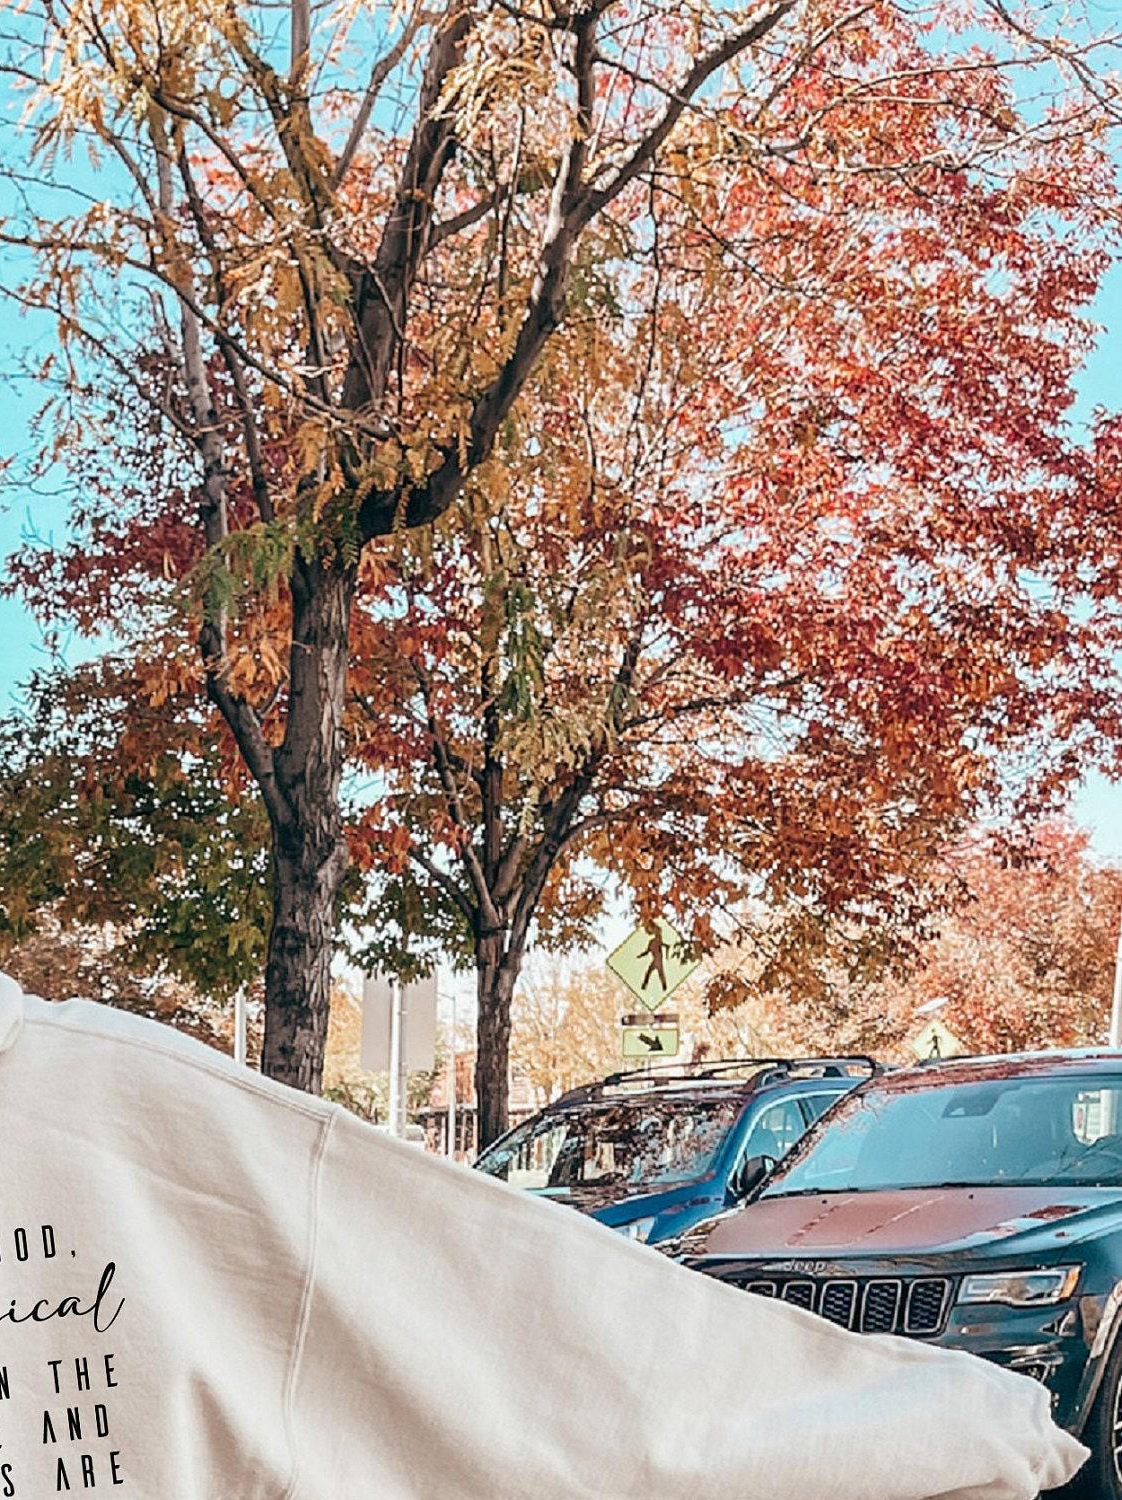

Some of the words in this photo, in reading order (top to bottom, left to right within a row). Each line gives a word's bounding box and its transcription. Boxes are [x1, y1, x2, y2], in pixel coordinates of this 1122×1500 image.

[782, 1258, 826, 1275] Jeep
[47, 1353, 118, 1394] THE
[42, 1403, 109, 1444] AND
[56, 1450, 124, 1492] ARE
